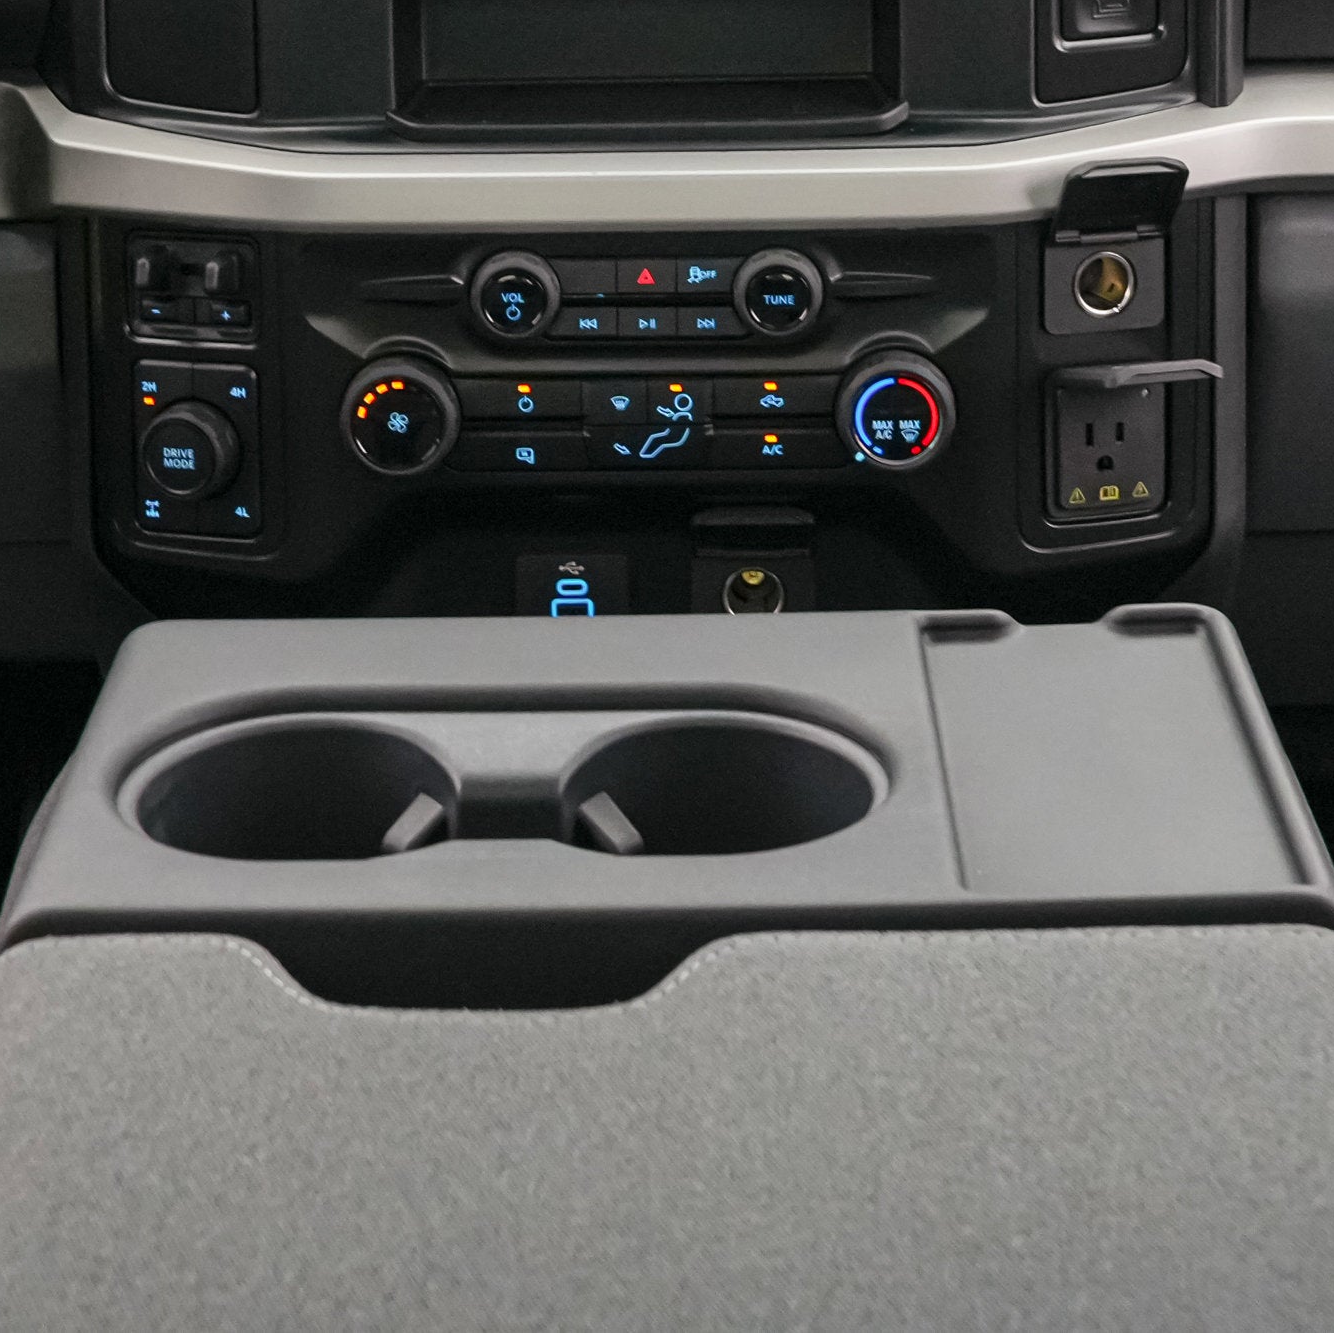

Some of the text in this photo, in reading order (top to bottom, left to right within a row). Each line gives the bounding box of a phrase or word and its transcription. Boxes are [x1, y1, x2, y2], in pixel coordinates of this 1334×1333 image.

[701, 269, 717, 280] OFF
[501, 292, 525, 304] VOL
[763, 294, 795, 306] TUNE
[872, 420, 893, 430] MAX
[899, 420, 921, 429] MAX
[875, 430, 892, 440] A/C
[163, 447, 195, 459] DRIVE
[762, 444, 784, 455] A/C
[163, 458, 195, 470] MODE
